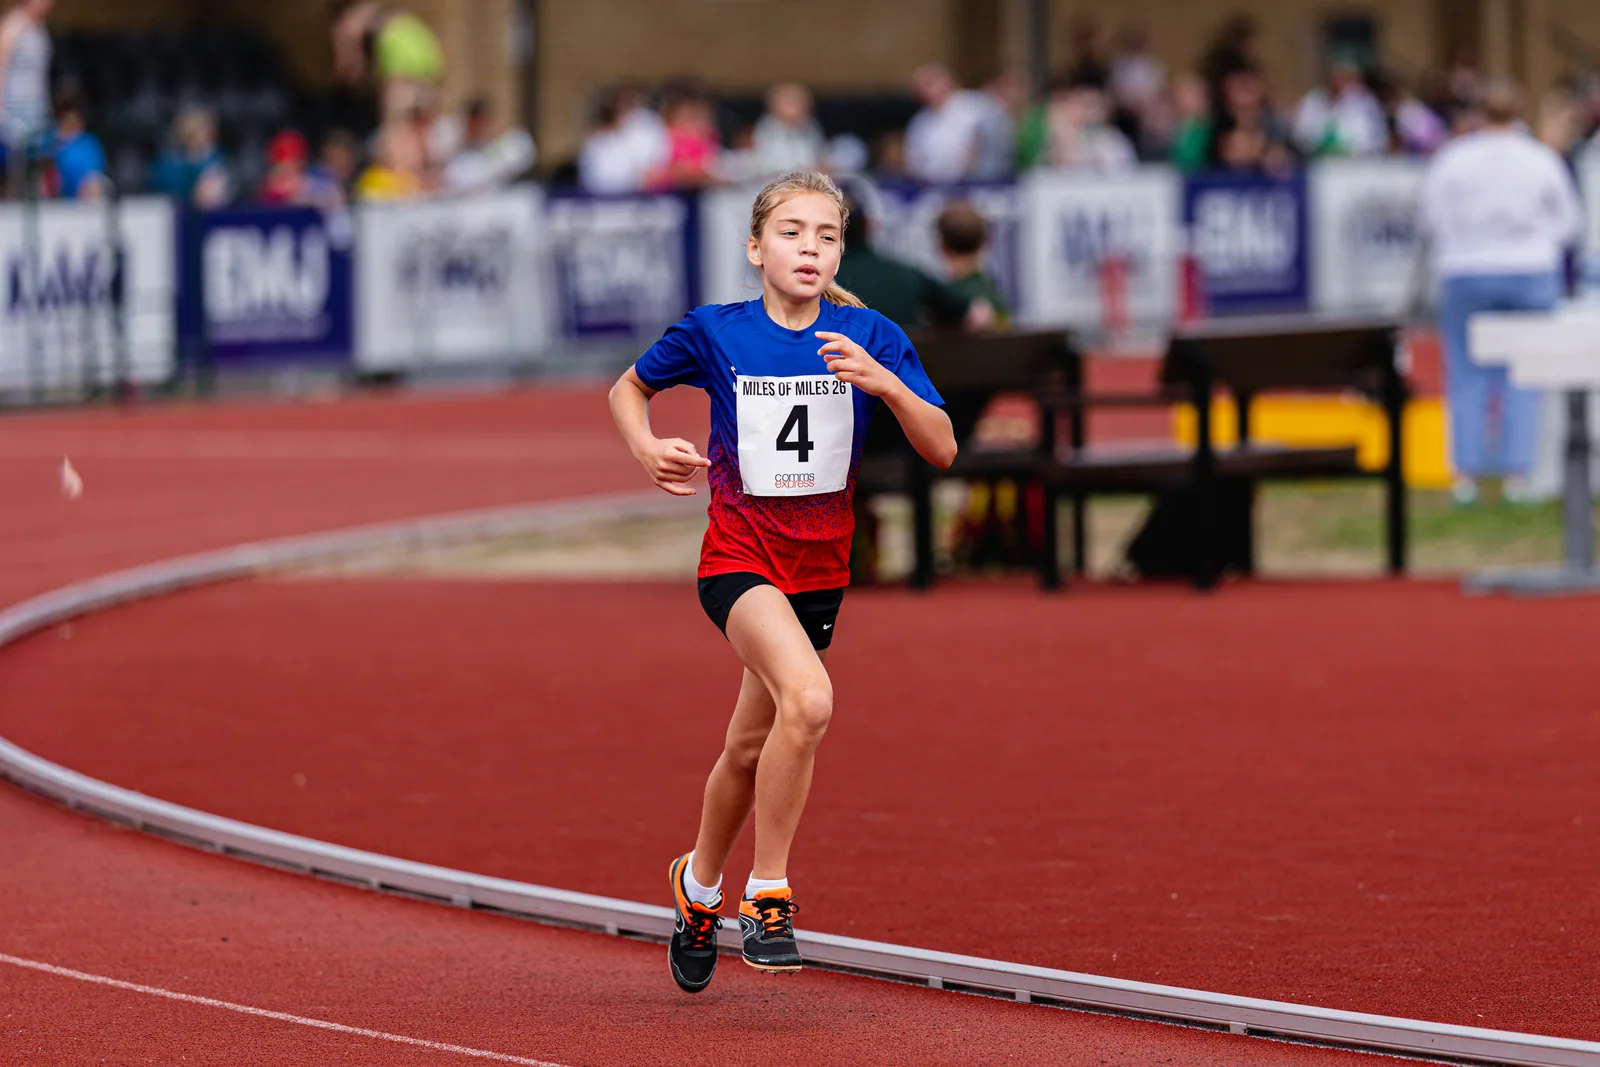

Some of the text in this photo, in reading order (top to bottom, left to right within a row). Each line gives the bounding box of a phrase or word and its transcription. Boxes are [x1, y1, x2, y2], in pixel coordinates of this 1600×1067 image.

[742, 381, 775, 396] MILES
[778, 381, 792, 396] OF
[795, 380, 829, 396] MILES
[832, 380, 846, 395] 26
[776, 404, 814, 463] 4
[774, 473, 815, 482] comms
[774, 480, 815, 489] express
